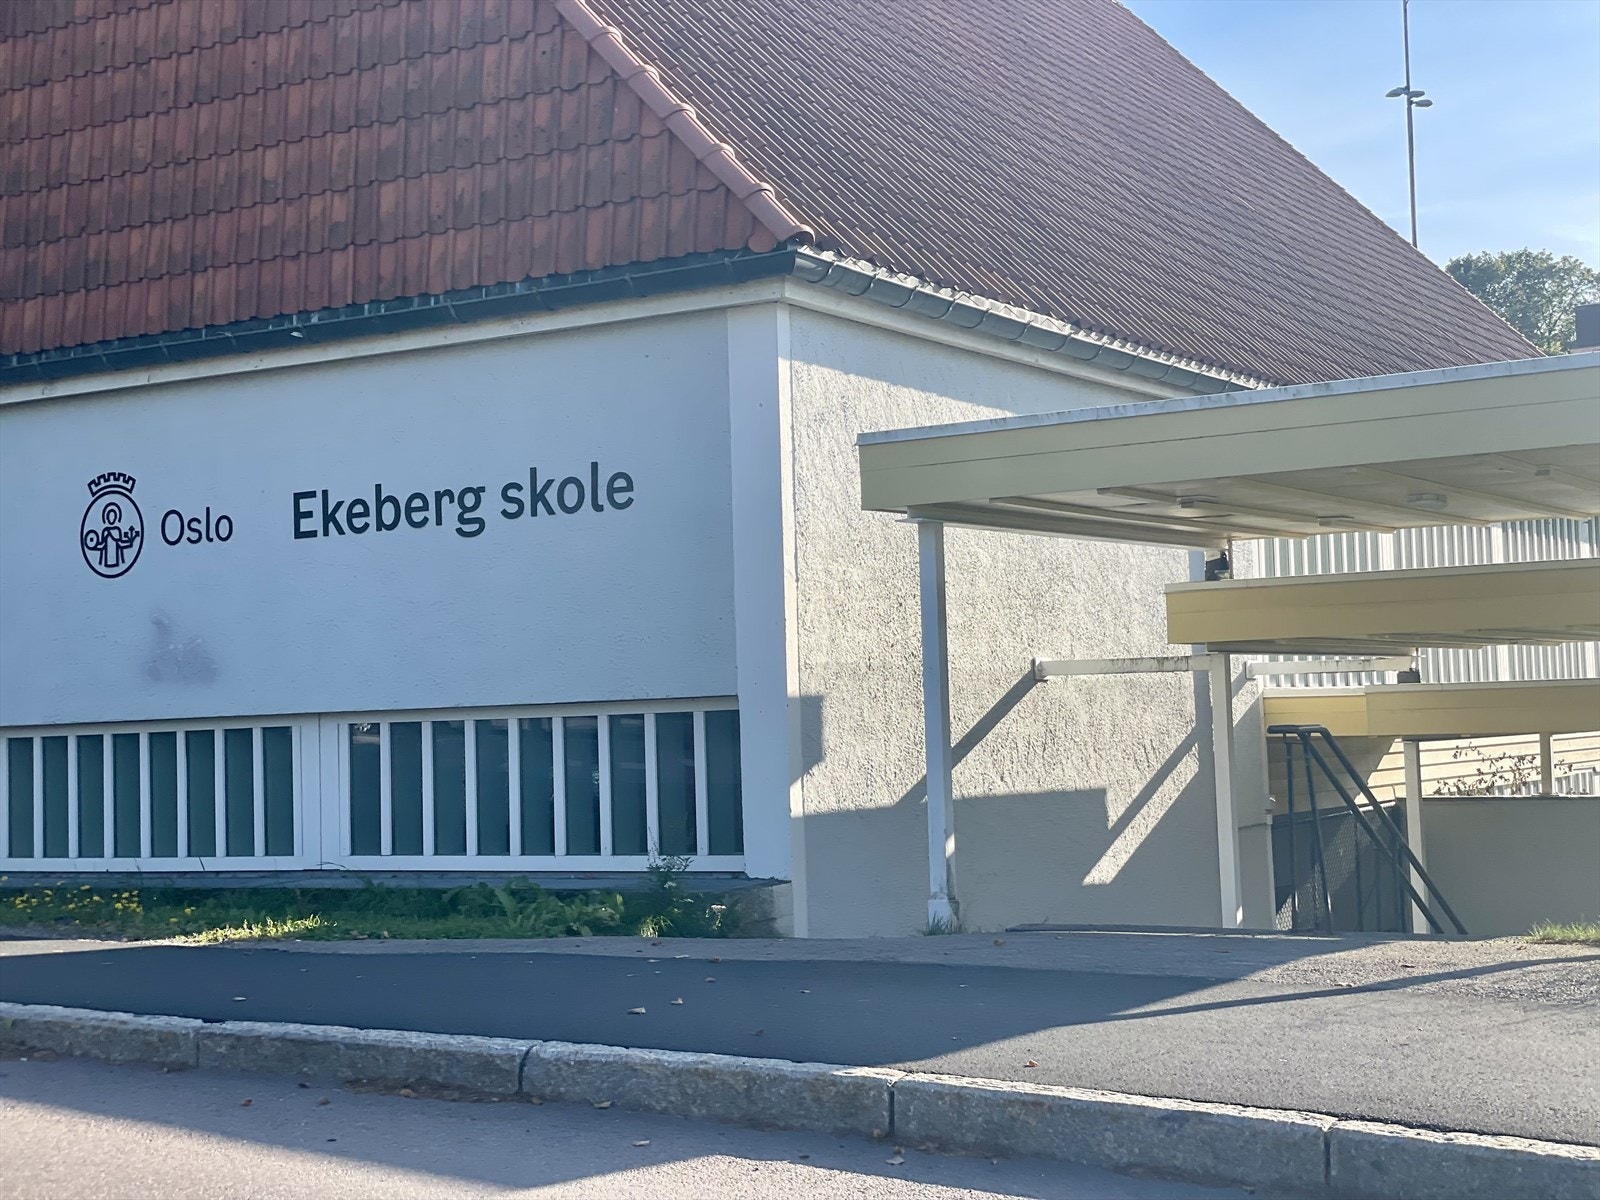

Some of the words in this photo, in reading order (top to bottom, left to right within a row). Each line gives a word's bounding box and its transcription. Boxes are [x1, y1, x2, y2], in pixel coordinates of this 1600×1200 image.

[160, 506, 234, 547] Oslo
[293, 484, 486, 539] Ekeberg
[500, 461, 635, 520] skole
